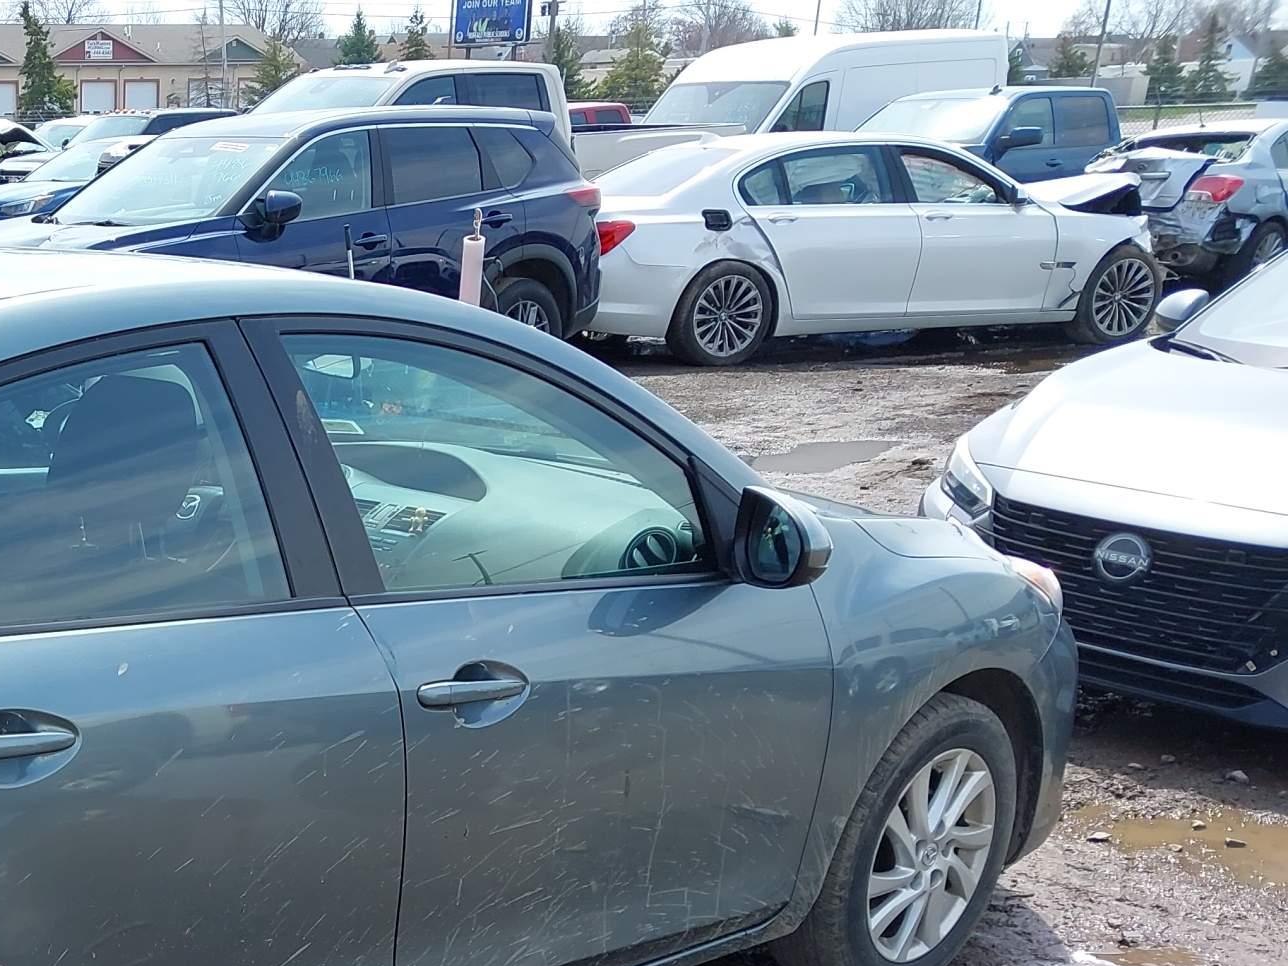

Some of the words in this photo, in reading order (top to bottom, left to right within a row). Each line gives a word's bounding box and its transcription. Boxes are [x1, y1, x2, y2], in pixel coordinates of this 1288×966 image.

[462, 0, 480, 9] JOIN
[481, 0, 499, 8] OUR
[1096, 549, 1149, 567] NISSAN
